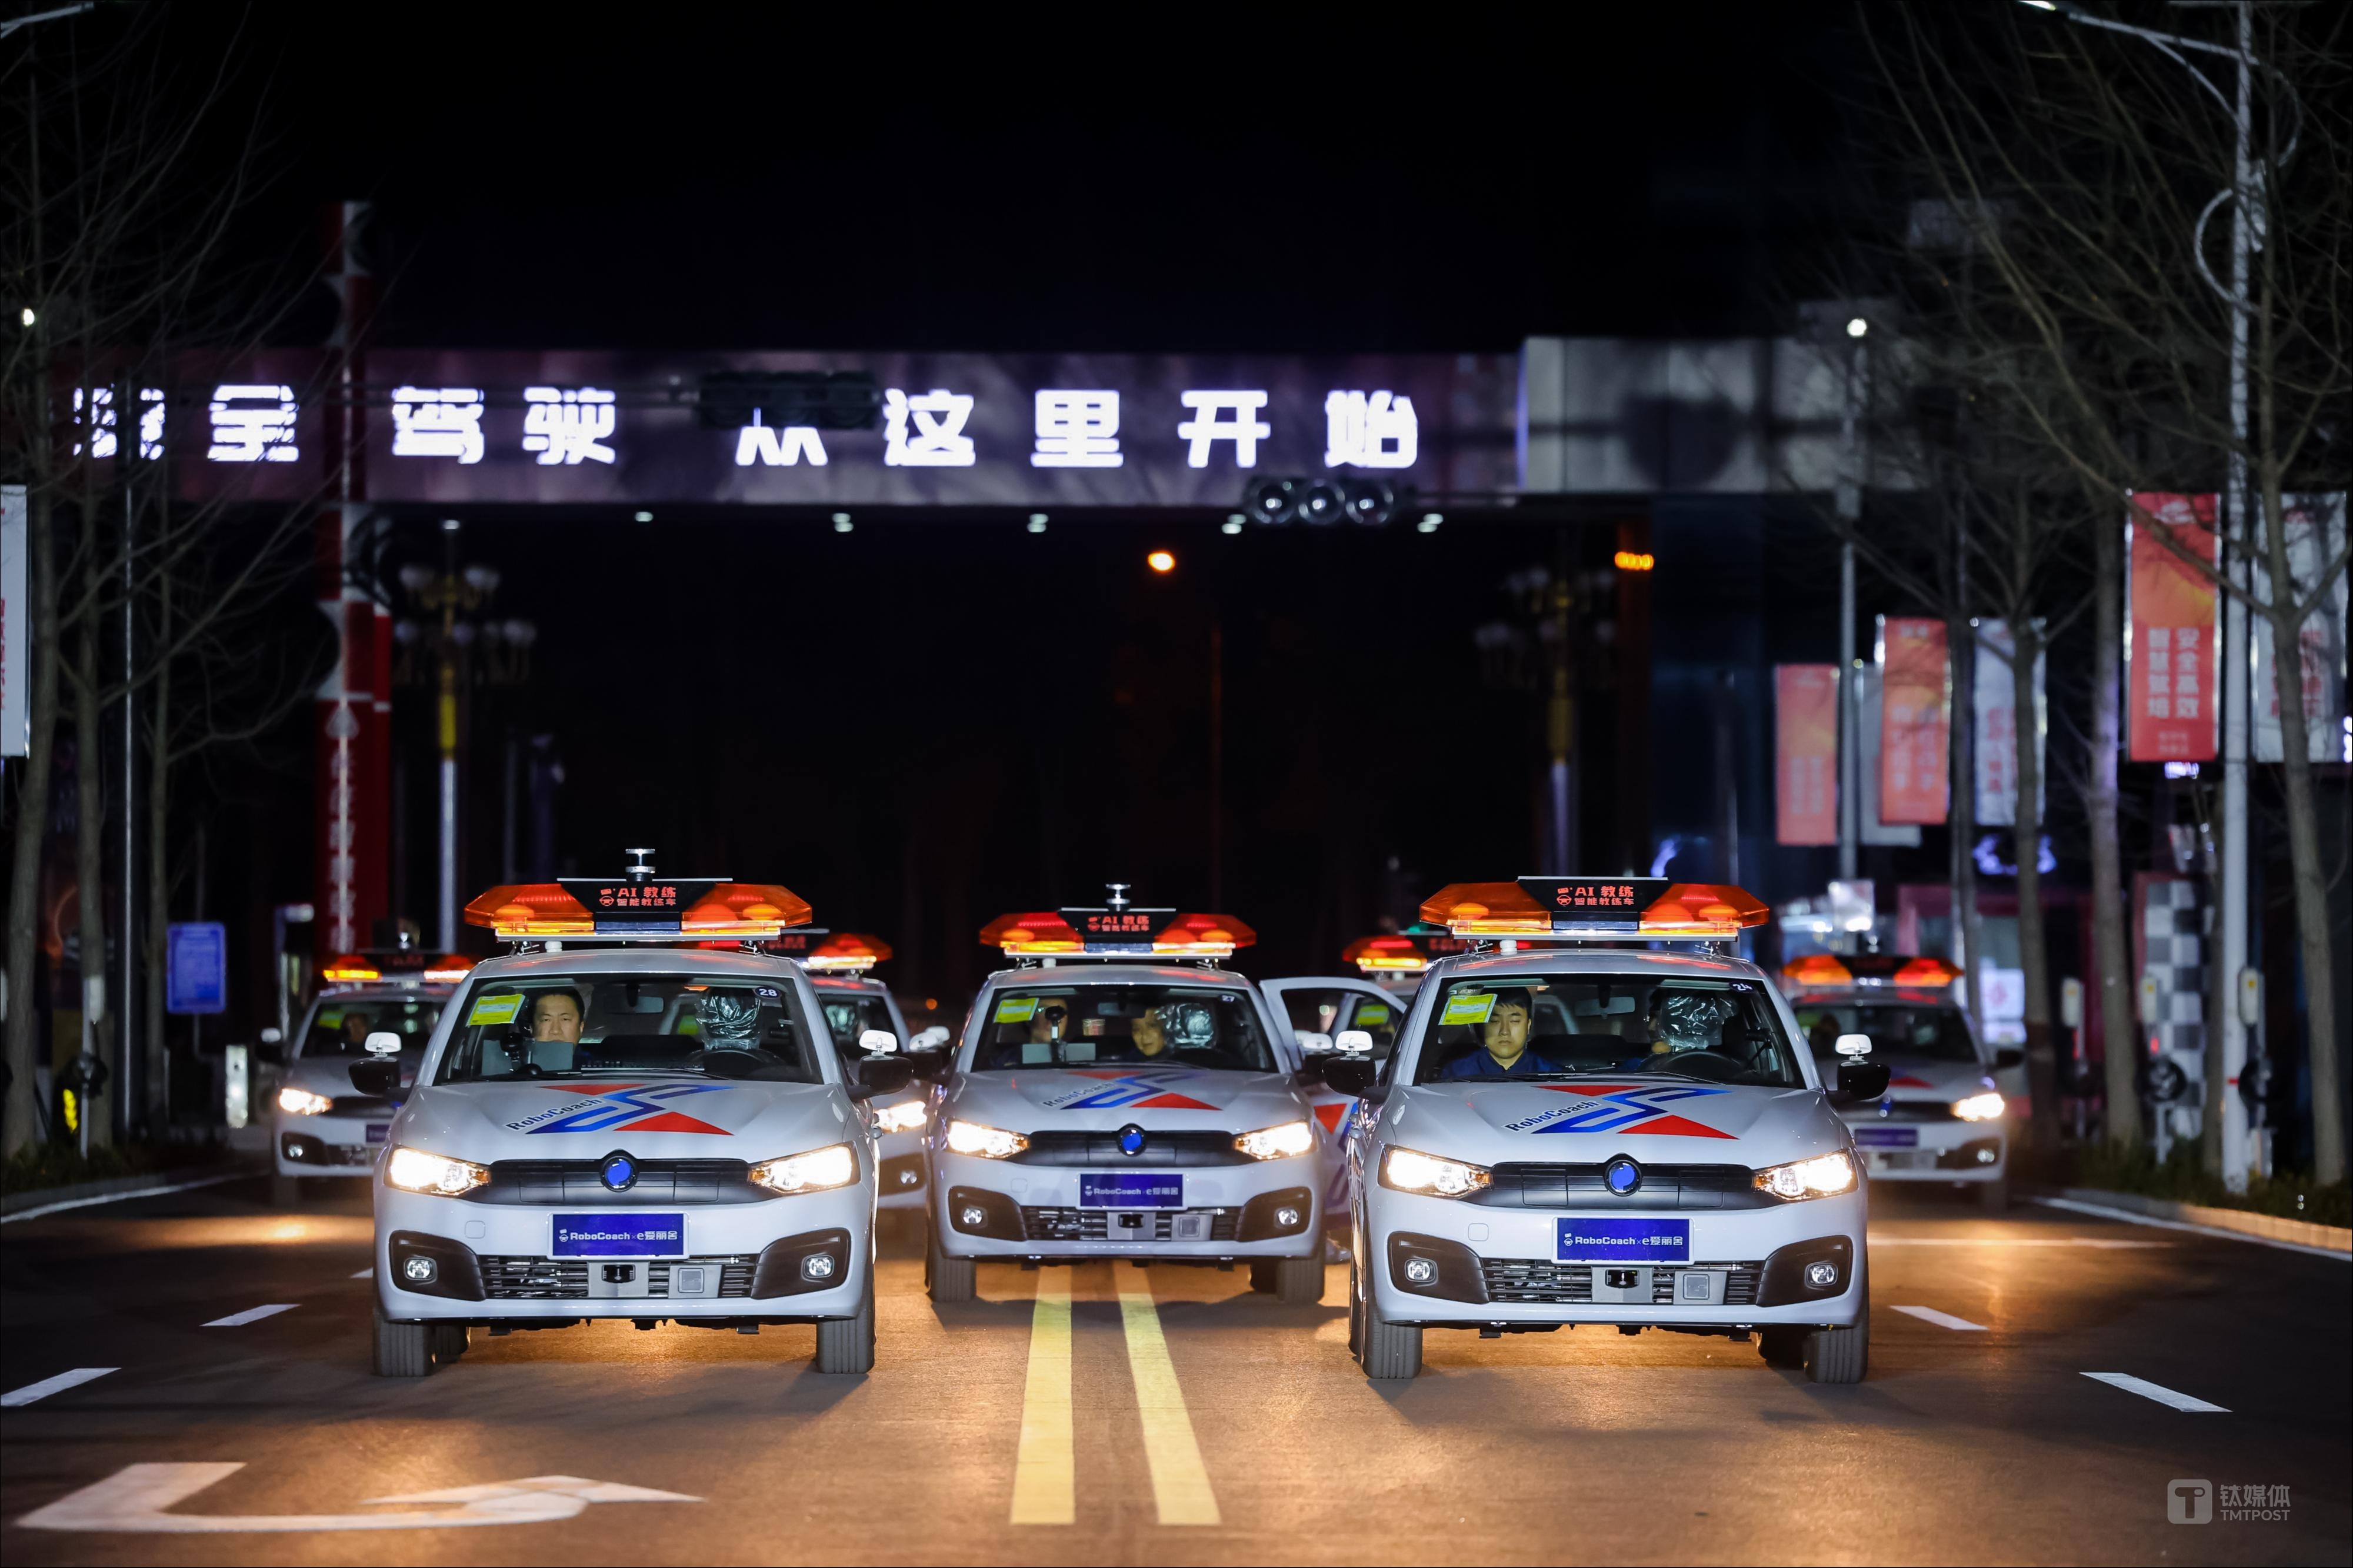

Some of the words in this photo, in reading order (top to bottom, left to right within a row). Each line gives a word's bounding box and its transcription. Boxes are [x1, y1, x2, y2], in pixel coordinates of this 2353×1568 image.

[617, 888, 638, 898] AI
[643, 886, 676, 898] 教练
[1575, 887, 1594, 896] AI
[1600, 886, 1634, 898] 教练
[616, 898, 676, 906] 智能教练车
[1574, 897, 1635, 906] 智能教练车
[505, 1098, 603, 1130] RoboCoach
[1504, 1101, 1600, 1131] RoboCoach
[570, 1232, 631, 1240] RoboCoach
[1575, 1236, 1635, 1245] RoboCoach
